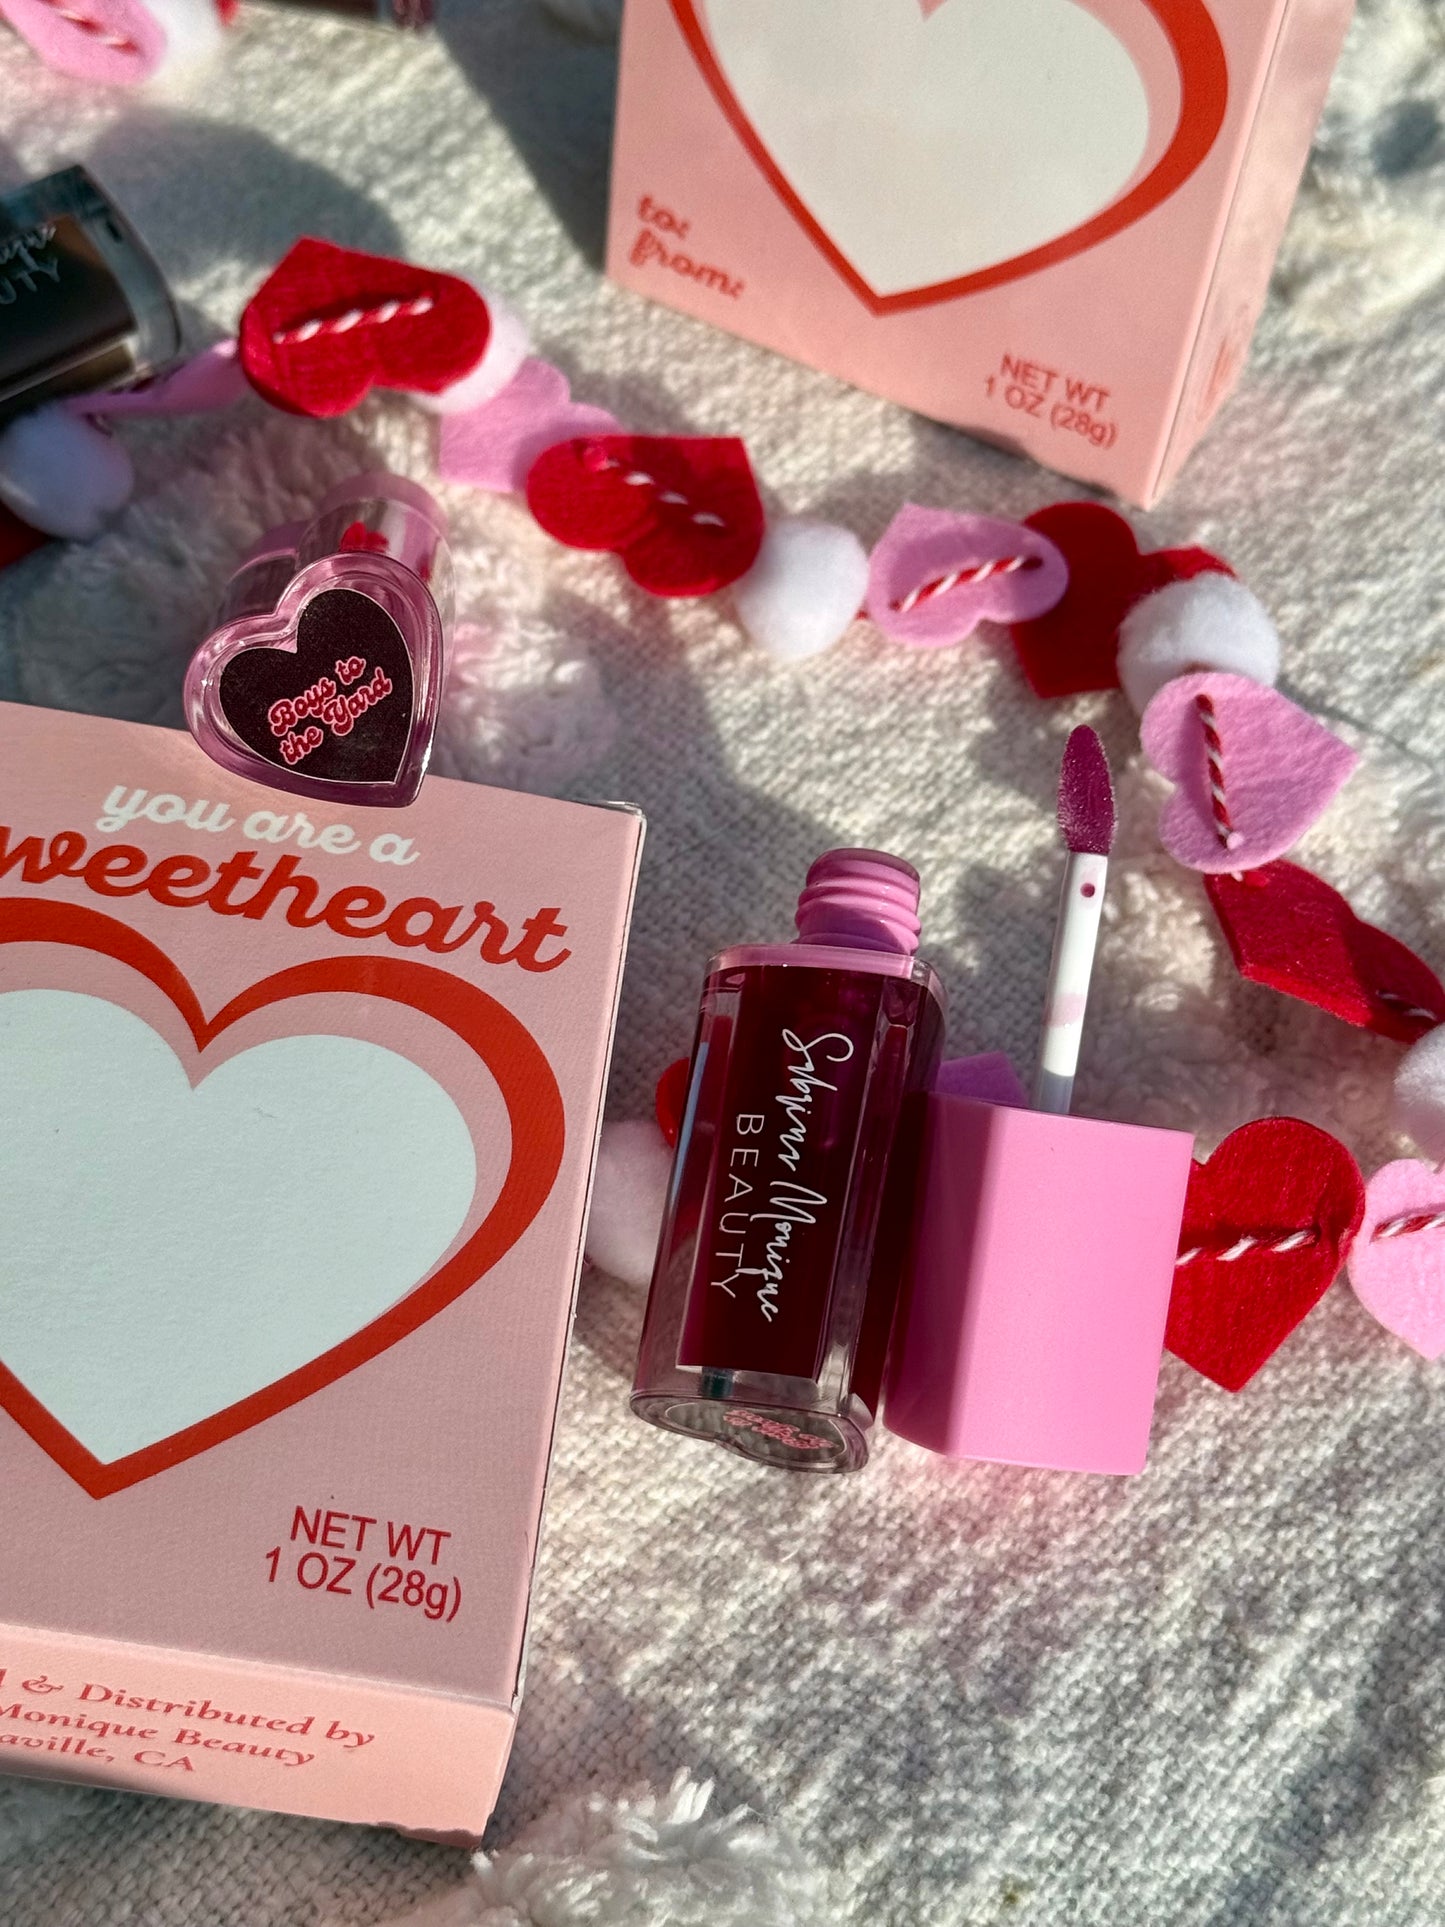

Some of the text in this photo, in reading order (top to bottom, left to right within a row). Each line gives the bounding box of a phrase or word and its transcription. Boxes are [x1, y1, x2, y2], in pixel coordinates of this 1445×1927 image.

[986, 375, 1118, 449] 1 OZ (28g)
[1001, 354, 1110, 411] NET WT
[268, 656, 366, 736] Boys to
[280, 666, 393, 765] the Yard
[96, 784, 420, 866] you are a
[710, 1113, 765, 1298] BEAUTY
[735, 1180, 828, 1323] Monique
[290, 1505, 451, 1565] NET WT
[265, 1546, 463, 1622] 1 OZ (28g)
[22, 1675, 64, 1694] &
[78, 1683, 315, 1736] Distributed
[326, 1720, 375, 1748] by
[172, 1728, 315, 1767] Beauty
[134, 1750, 194, 1771] CA
